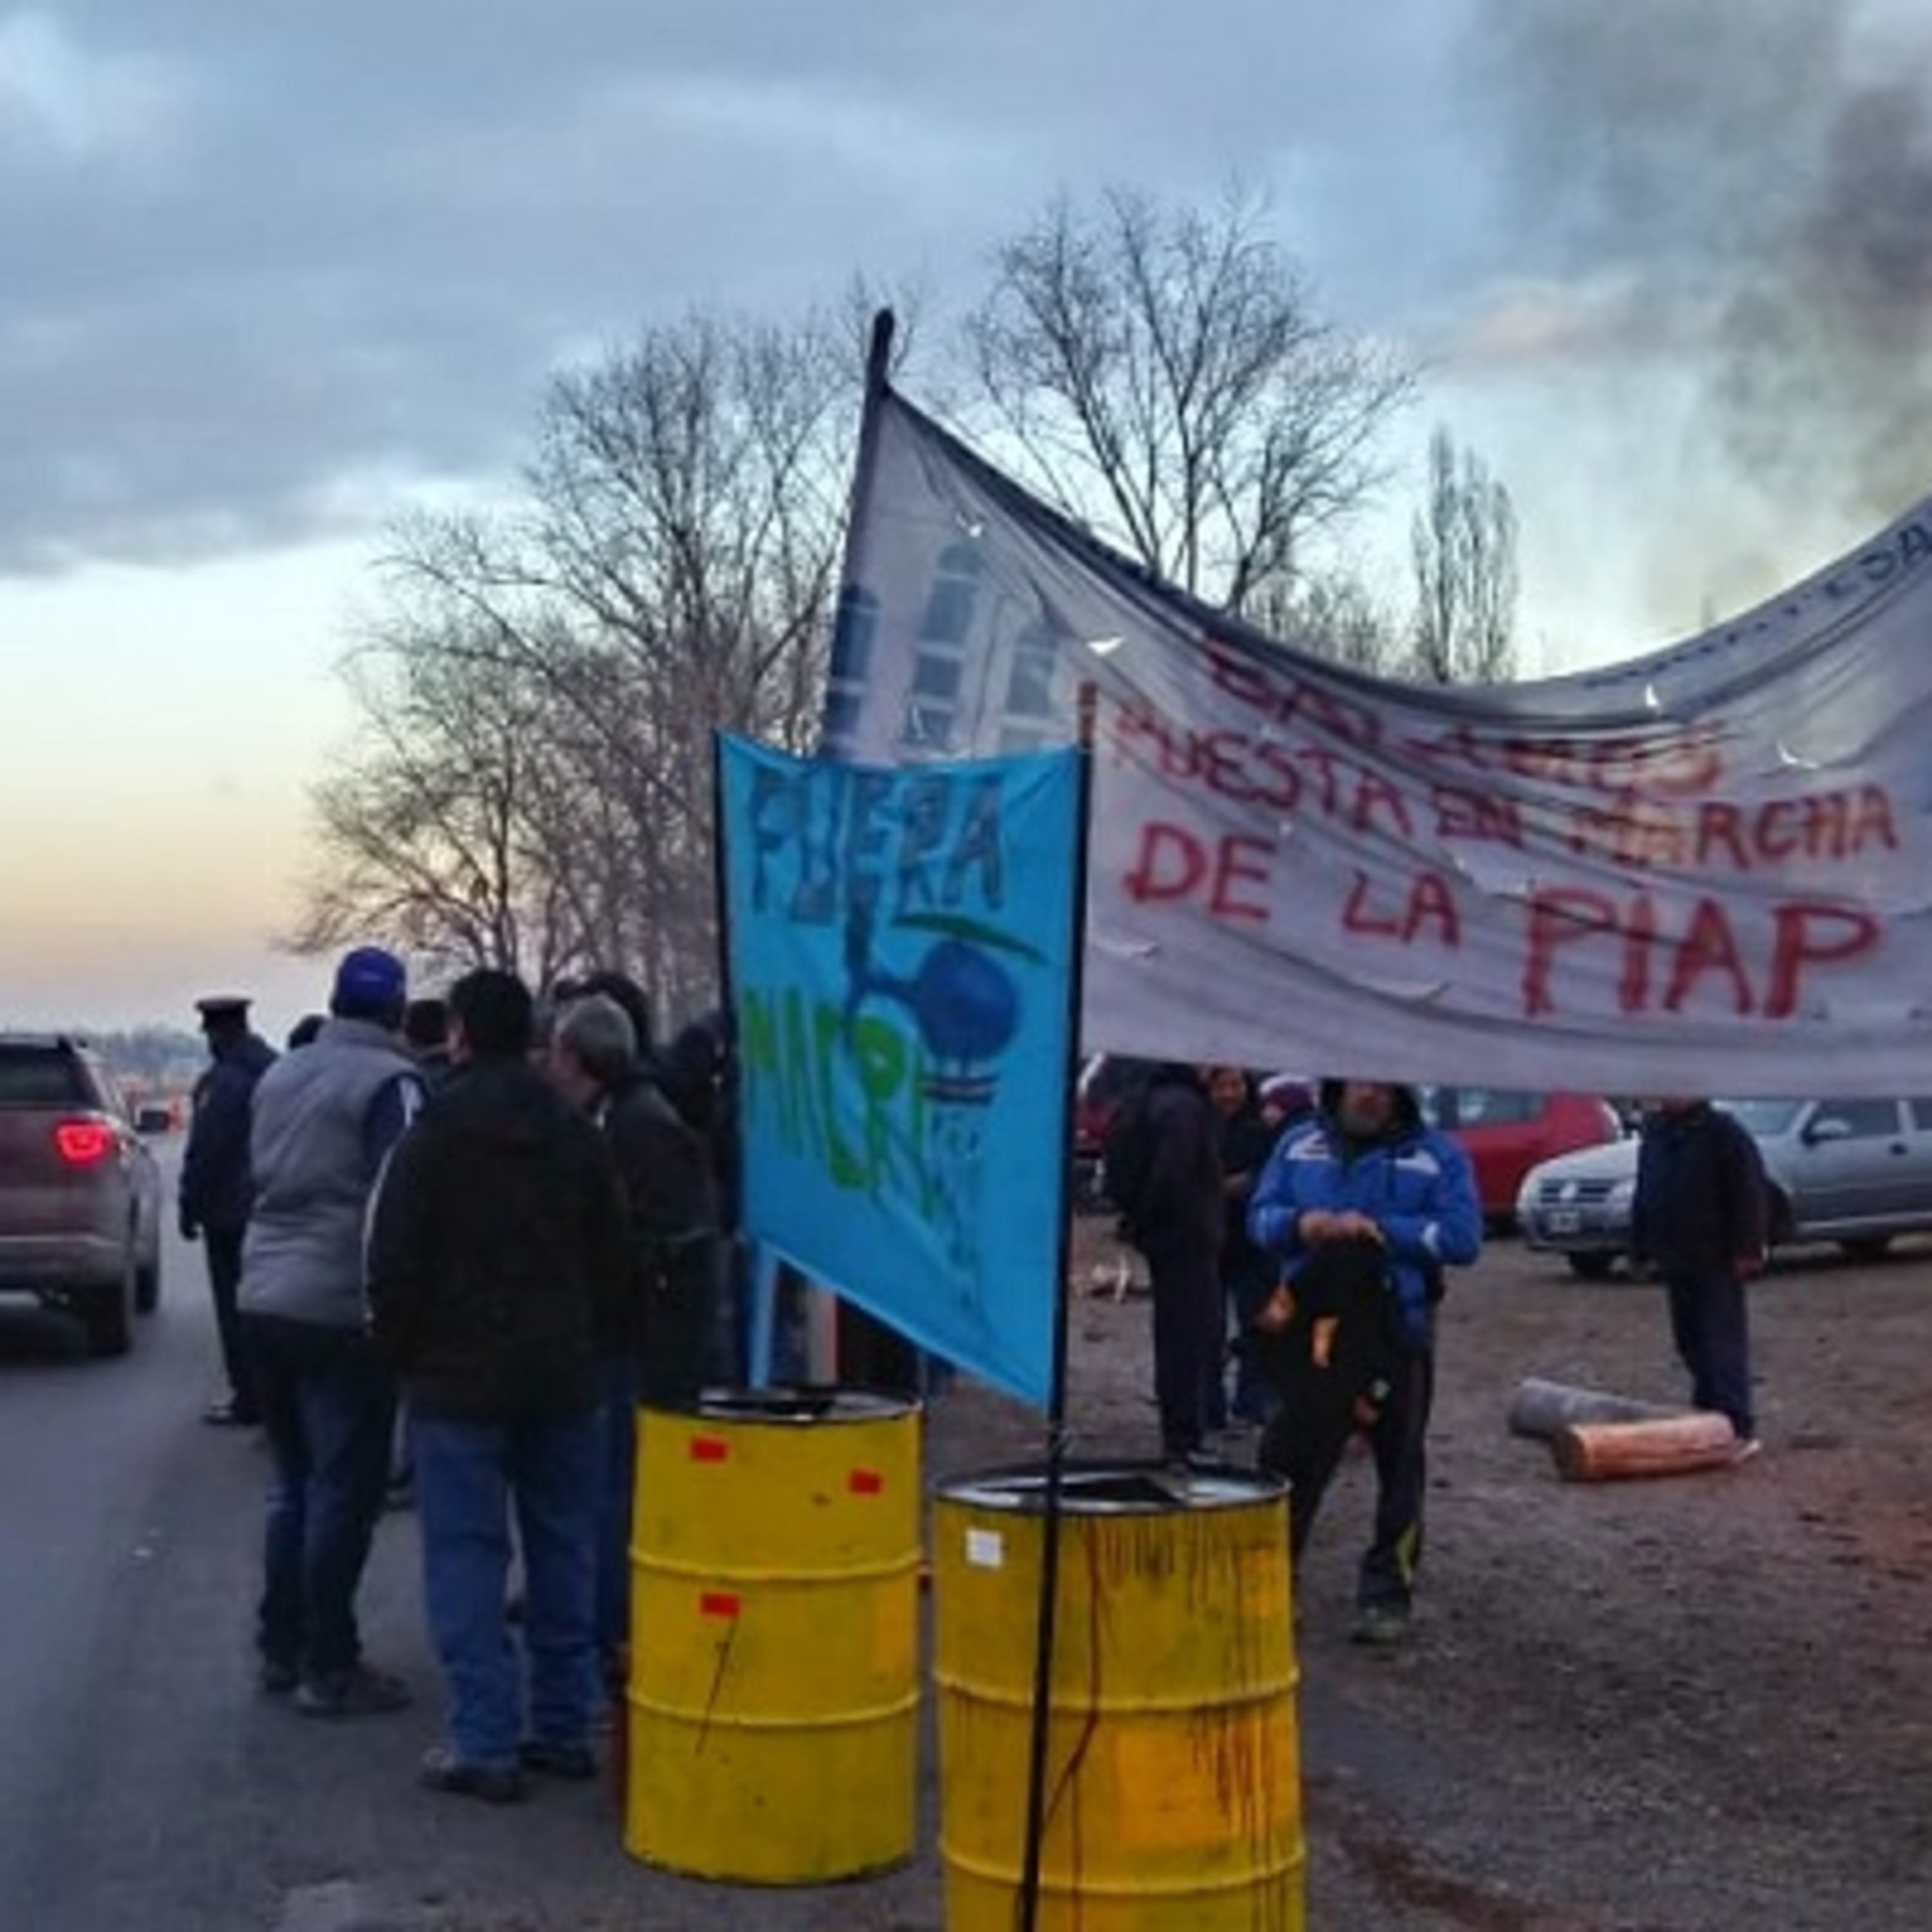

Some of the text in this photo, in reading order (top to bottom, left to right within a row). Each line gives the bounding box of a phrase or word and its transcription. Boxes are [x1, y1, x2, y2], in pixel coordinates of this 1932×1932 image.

[1122, 822, 1882, 1020] DE LA PIAP
